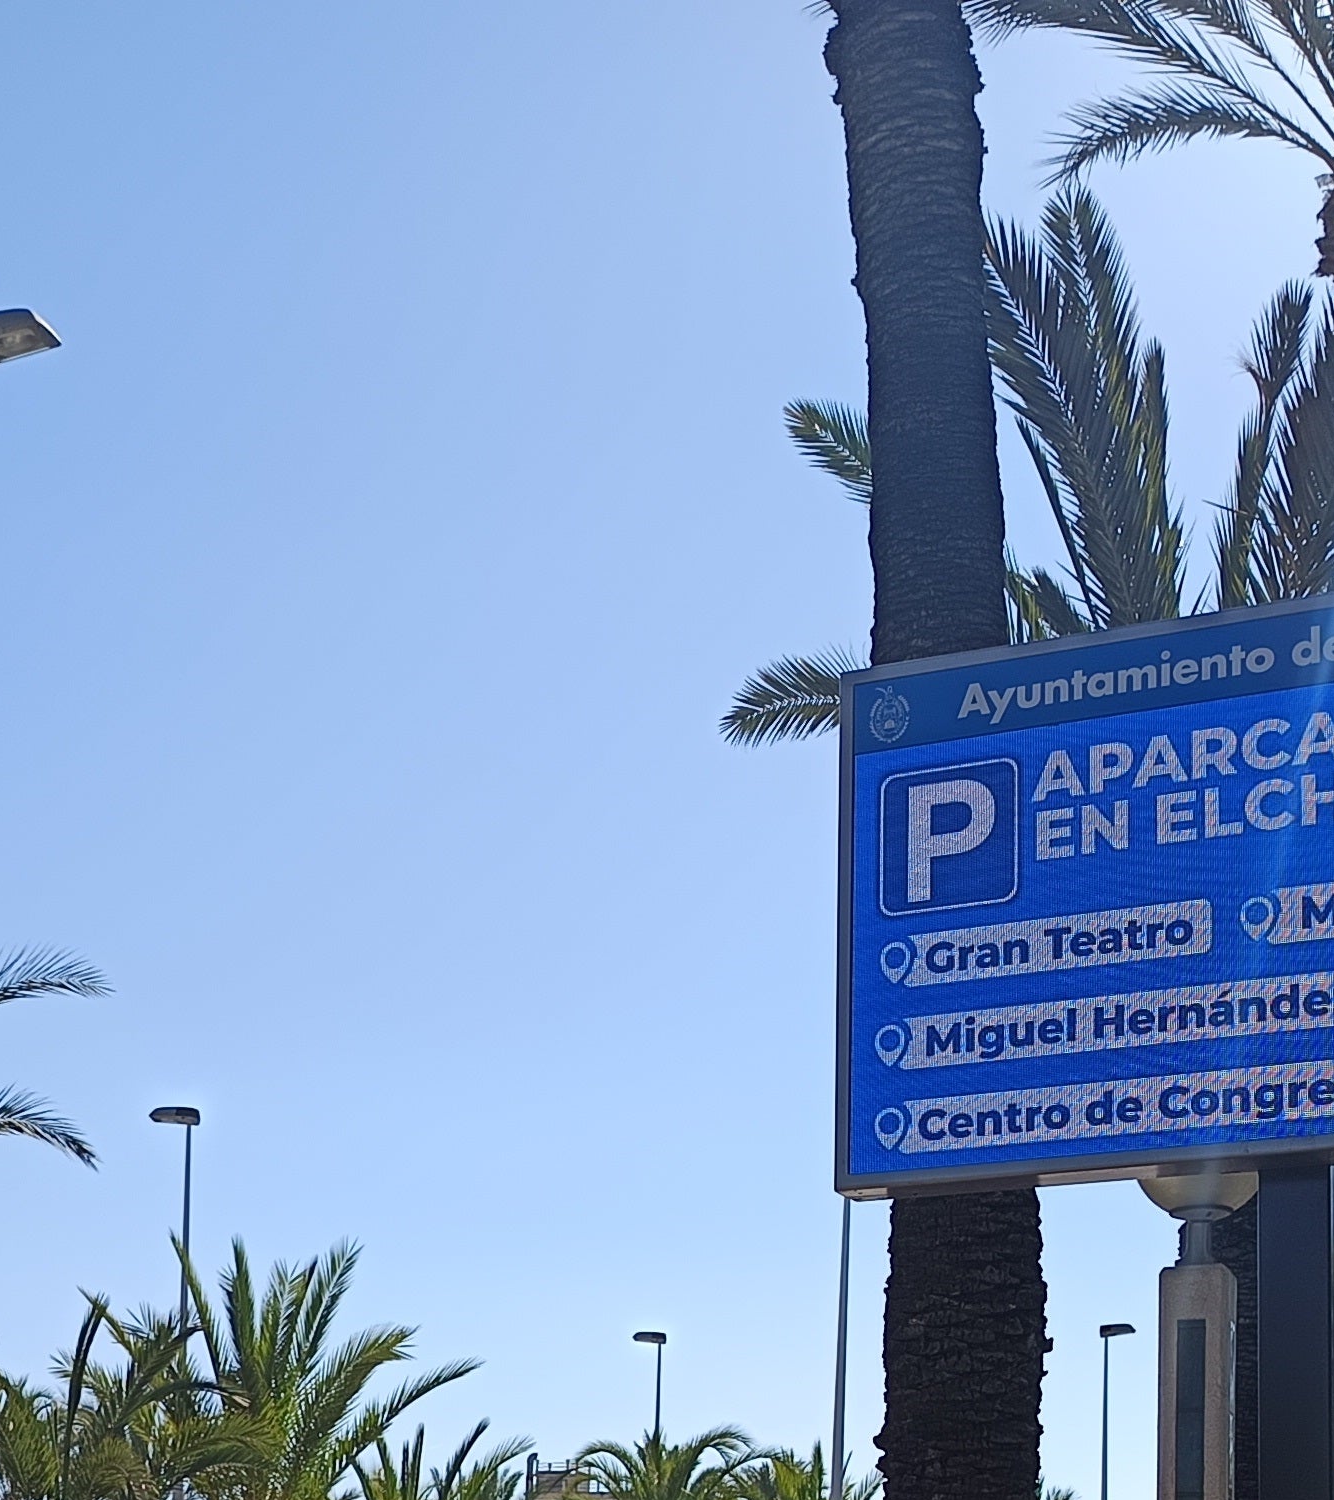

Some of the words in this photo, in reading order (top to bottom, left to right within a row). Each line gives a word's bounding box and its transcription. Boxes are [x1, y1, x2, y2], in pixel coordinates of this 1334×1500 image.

[957, 645, 1275, 725] Ayuntamiento
[906, 778, 996, 903] P
[1035, 799, 1130, 861] EN
[925, 936, 1031, 975] Gran
[1043, 918, 1194, 960] Teatro
[925, 1007, 1078, 1059] Miguel
[917, 1102, 1071, 1141] Centro
[1085, 1090, 1144, 1127] de
